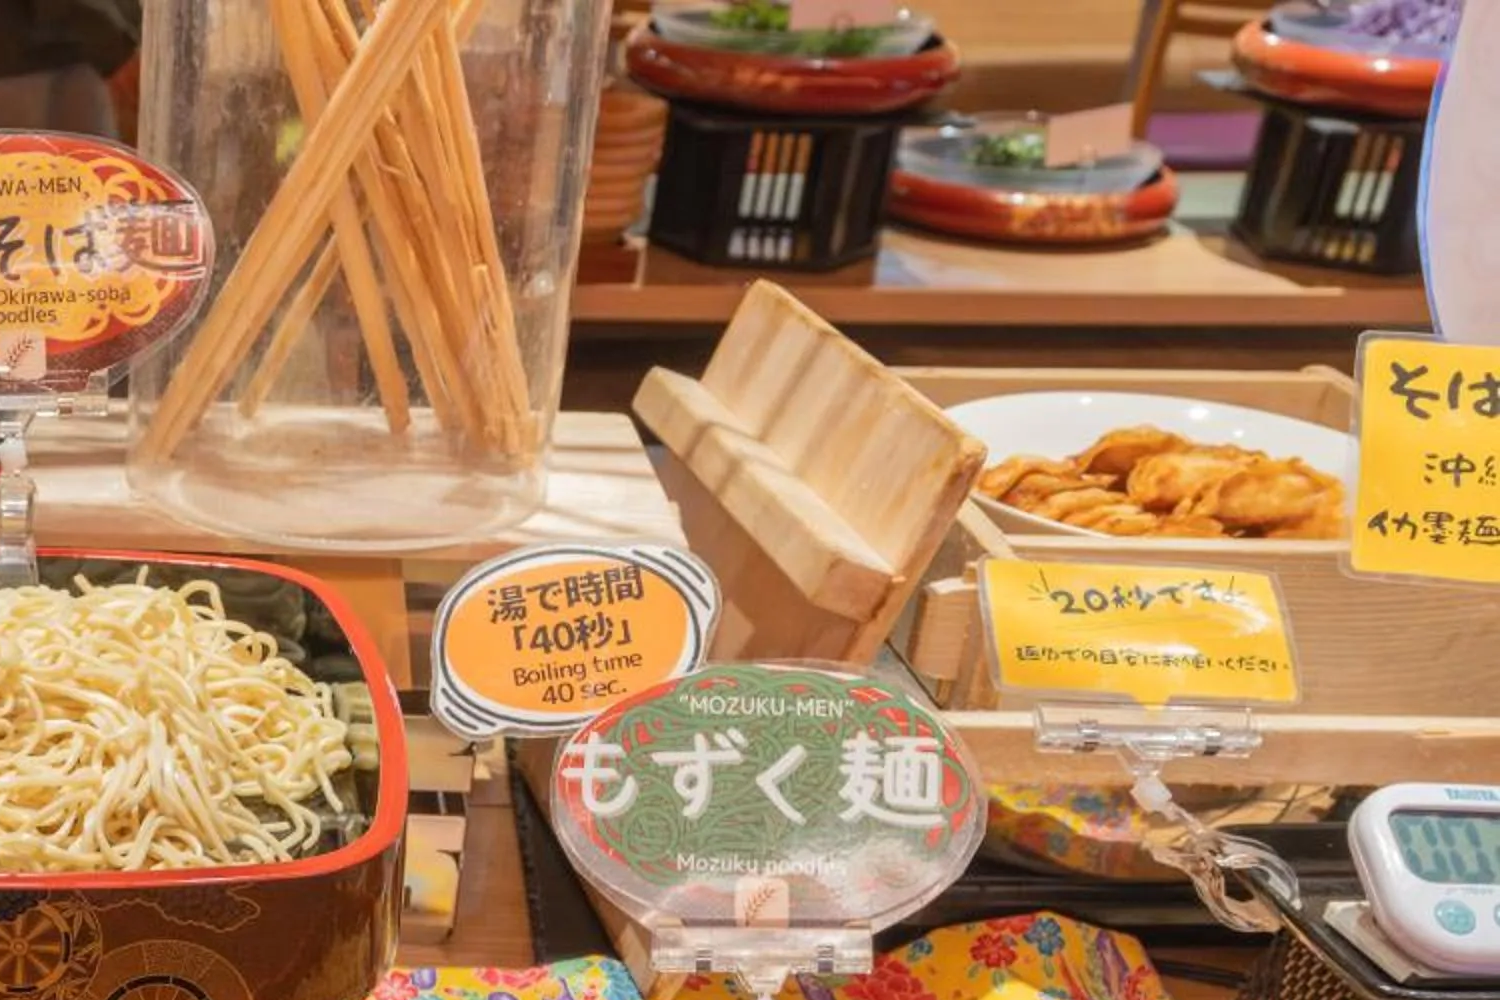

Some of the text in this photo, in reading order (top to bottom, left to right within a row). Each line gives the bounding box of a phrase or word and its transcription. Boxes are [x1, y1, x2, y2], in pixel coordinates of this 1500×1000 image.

[487, 563, 644, 624] 湯で時間
[512, 611, 632, 654] 「40秒」
[513, 652, 643, 687] Boiling time
[541, 678, 628, 705] 40 sec.
[560, 730, 948, 828] もずく麺
[677, 854, 758, 872] Mozuku
